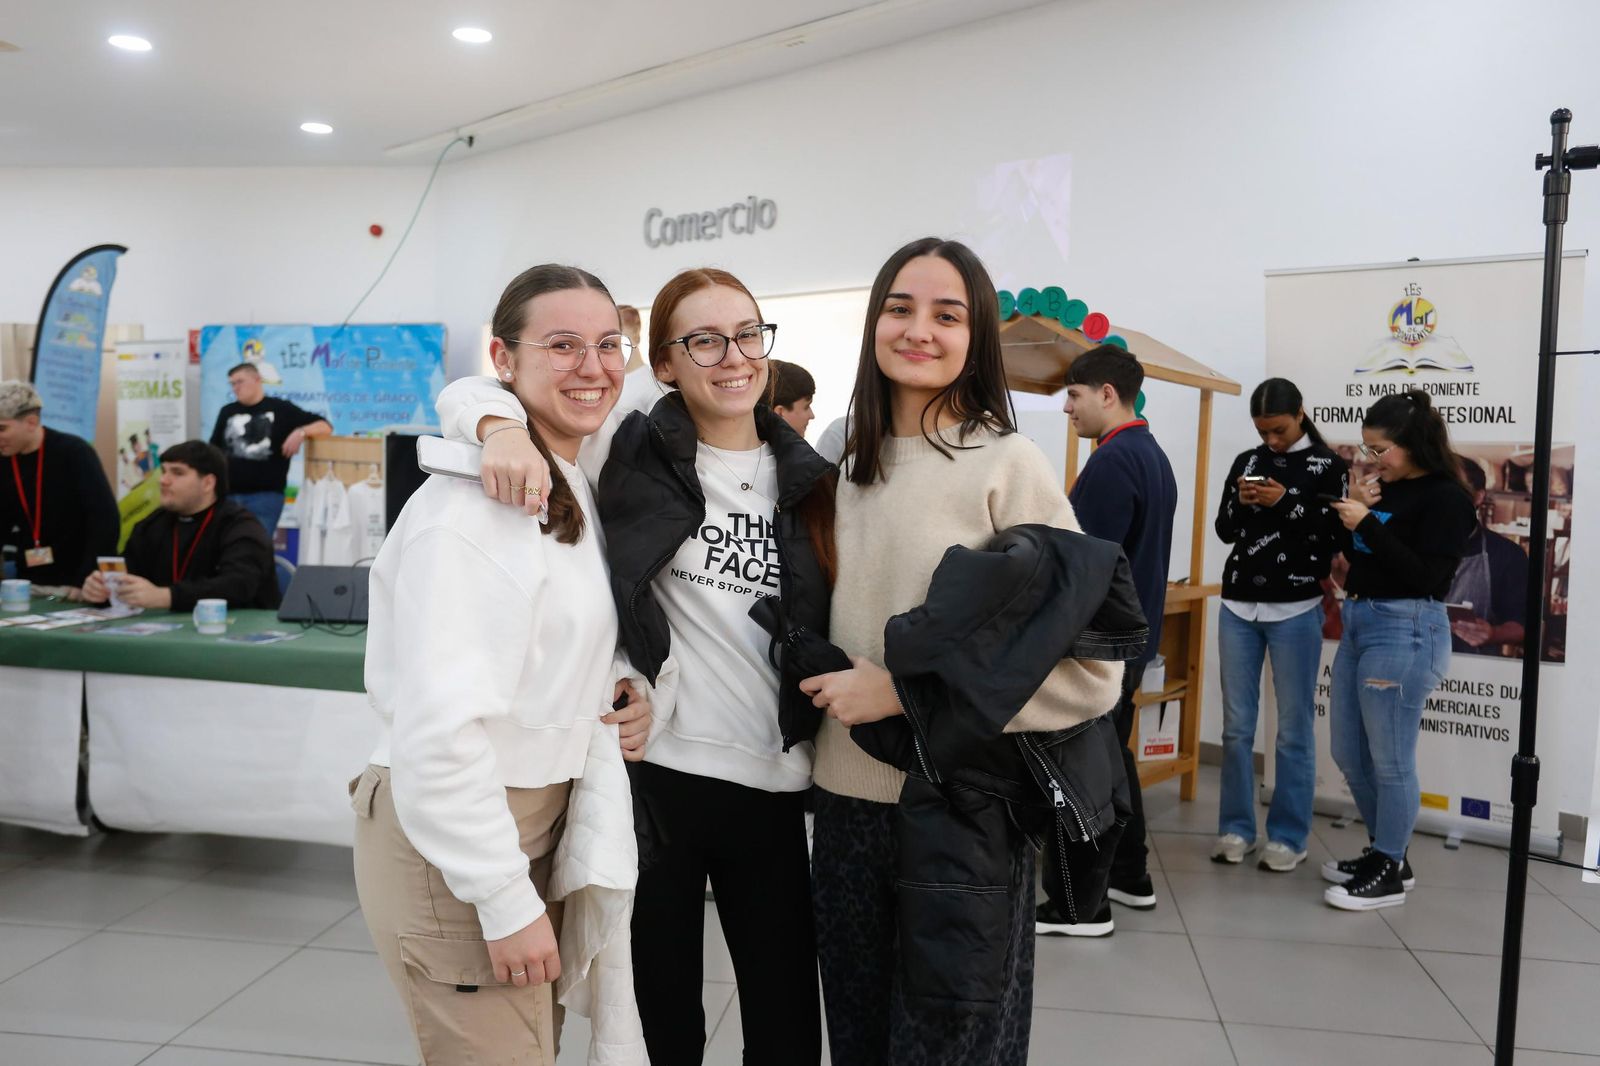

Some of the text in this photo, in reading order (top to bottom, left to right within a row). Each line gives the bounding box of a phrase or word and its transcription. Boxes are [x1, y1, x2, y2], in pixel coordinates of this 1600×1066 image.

[643, 195, 777, 249] Comercio
[1049, 290, 1061, 311] B
[1064, 304, 1077, 324] C
[1090, 314, 1105, 337] D
[1346, 383, 1363, 397] IES
[1369, 383, 1396, 397] MAR
[1422, 382, 1480, 396] PONIENTE
[1313, 406, 1516, 424] FORMA FESIONAL
[704, 545, 781, 588] FACE
[670, 567, 715, 587] NEVER
[717, 581, 752, 595] STOP
[1434, 679, 1494, 697] RCIALES
[1500, 684, 1522, 701] DU
